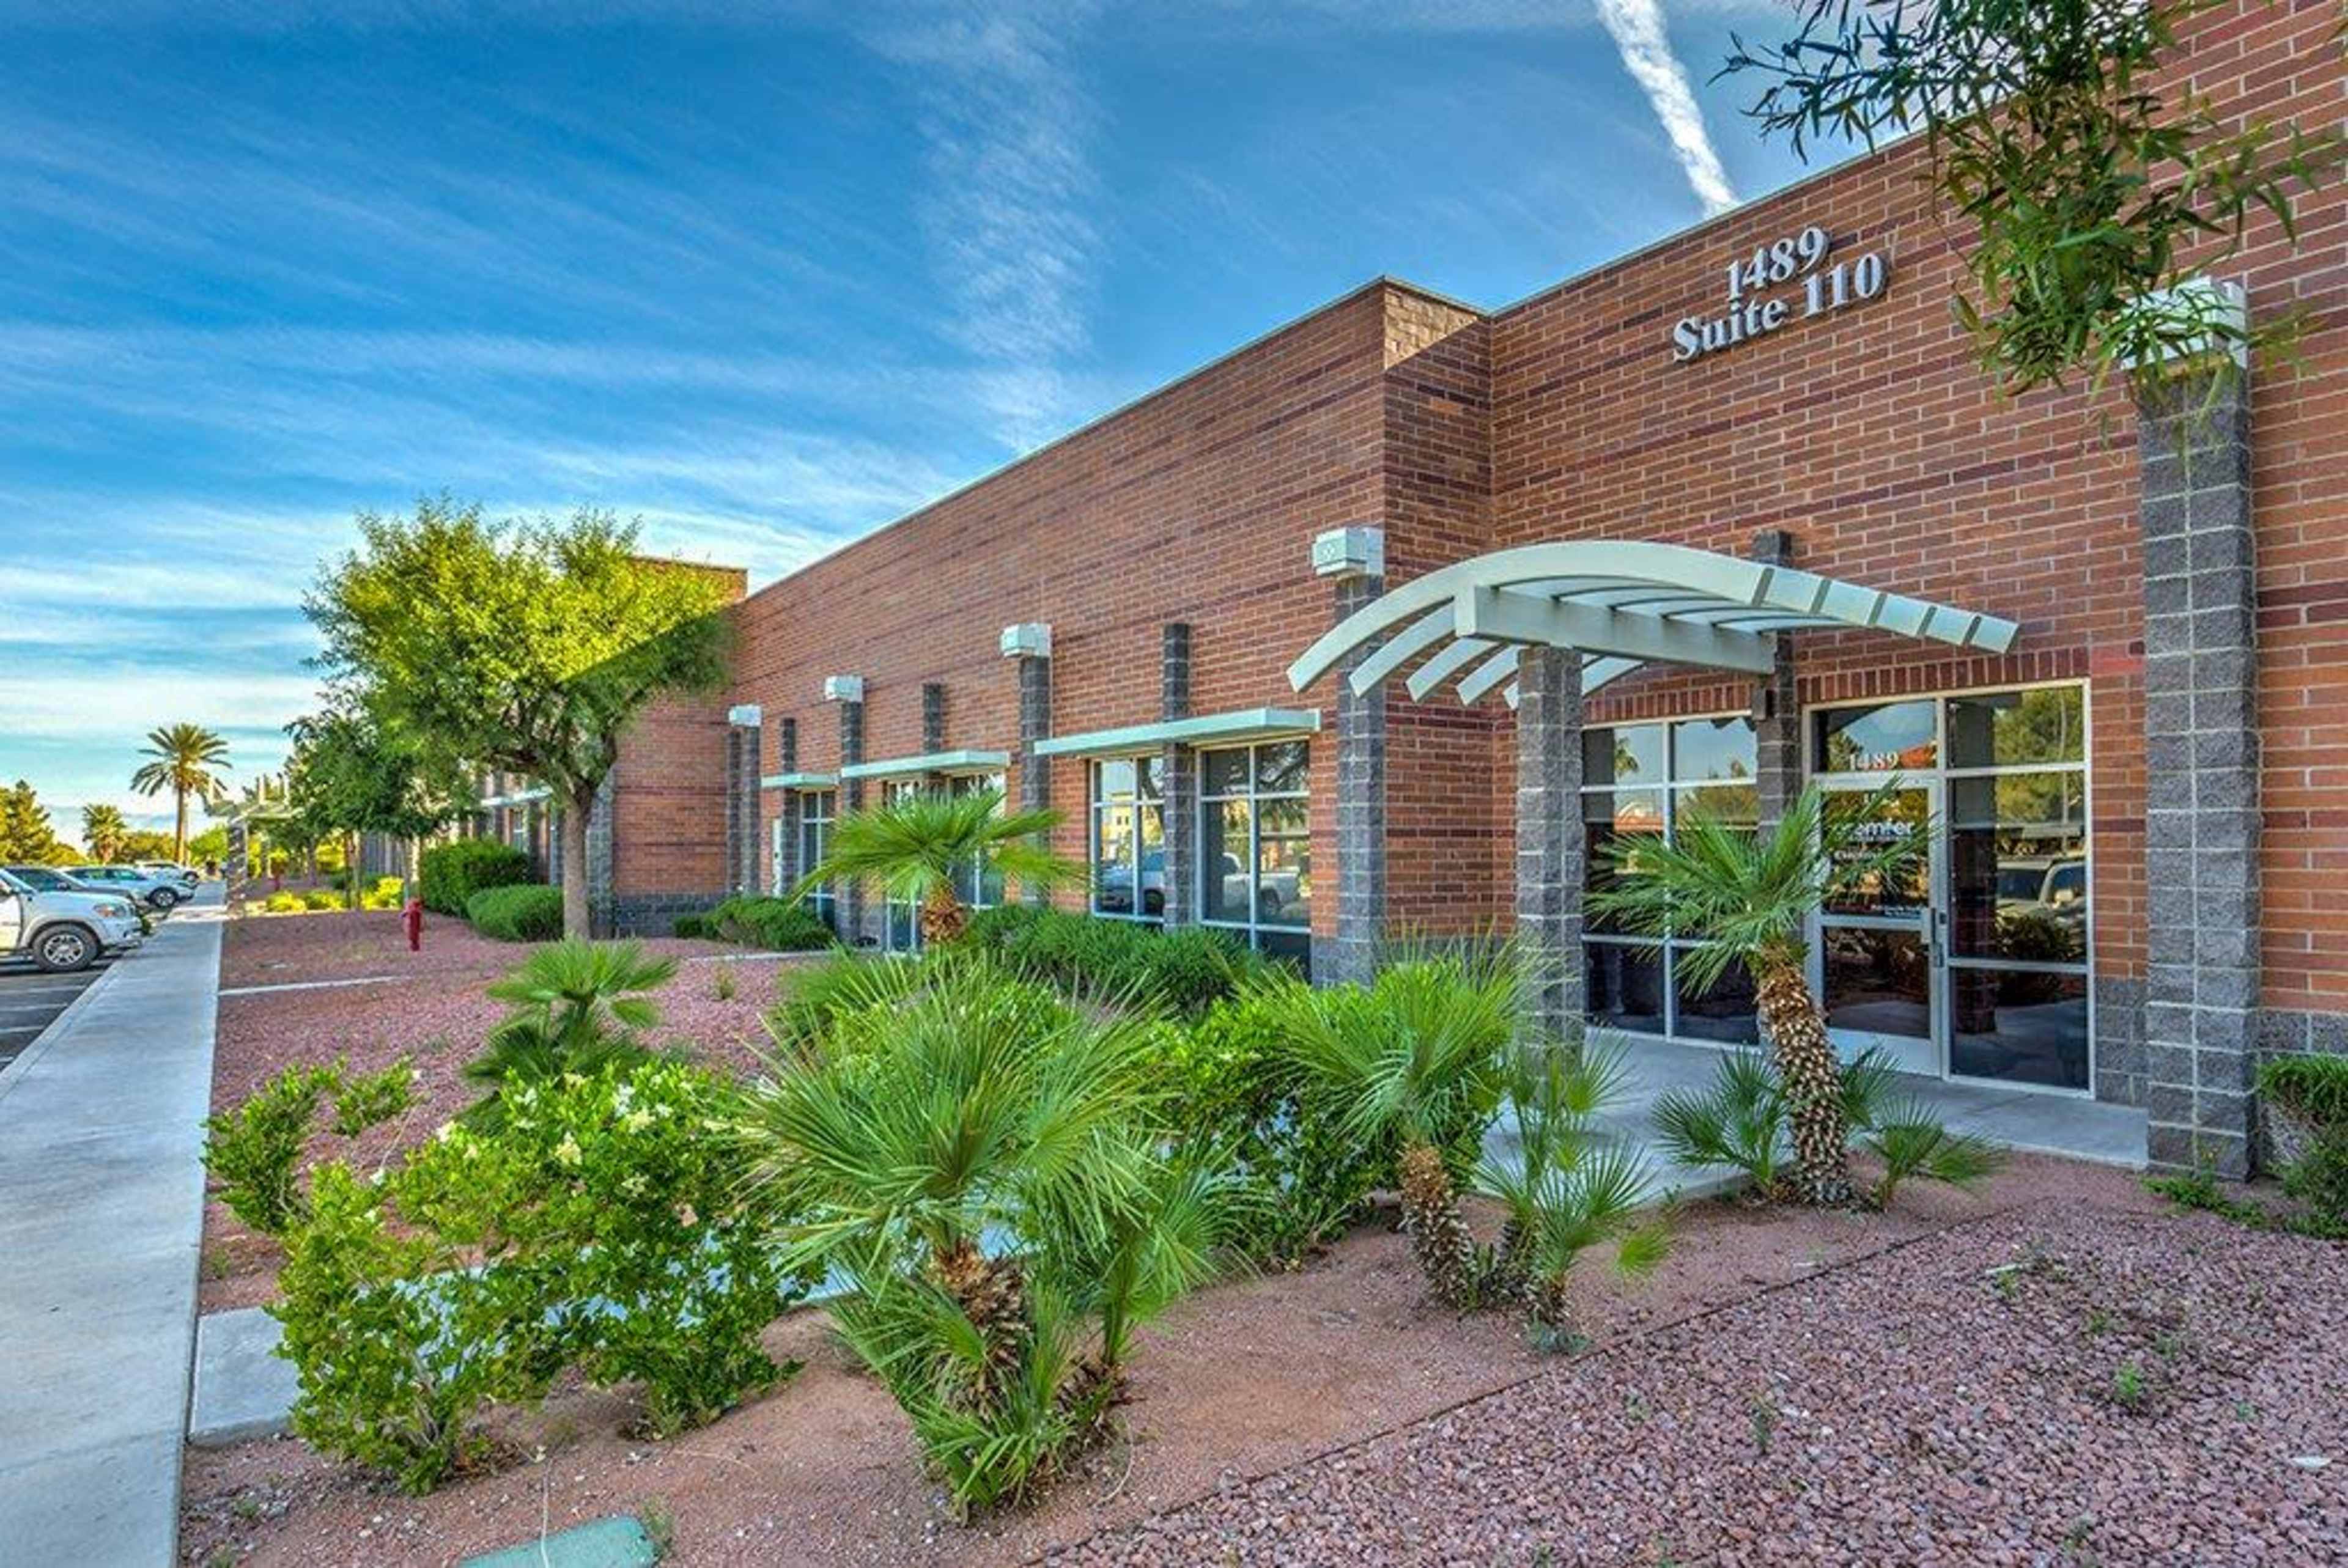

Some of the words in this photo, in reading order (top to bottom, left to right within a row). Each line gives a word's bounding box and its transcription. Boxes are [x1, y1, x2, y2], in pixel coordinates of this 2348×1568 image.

[1726, 226, 1829, 301] 1489
[1672, 296, 1789, 362] Suite
[1801, 252, 1886, 317] 110
[1849, 751, 1899, 771] 1489
